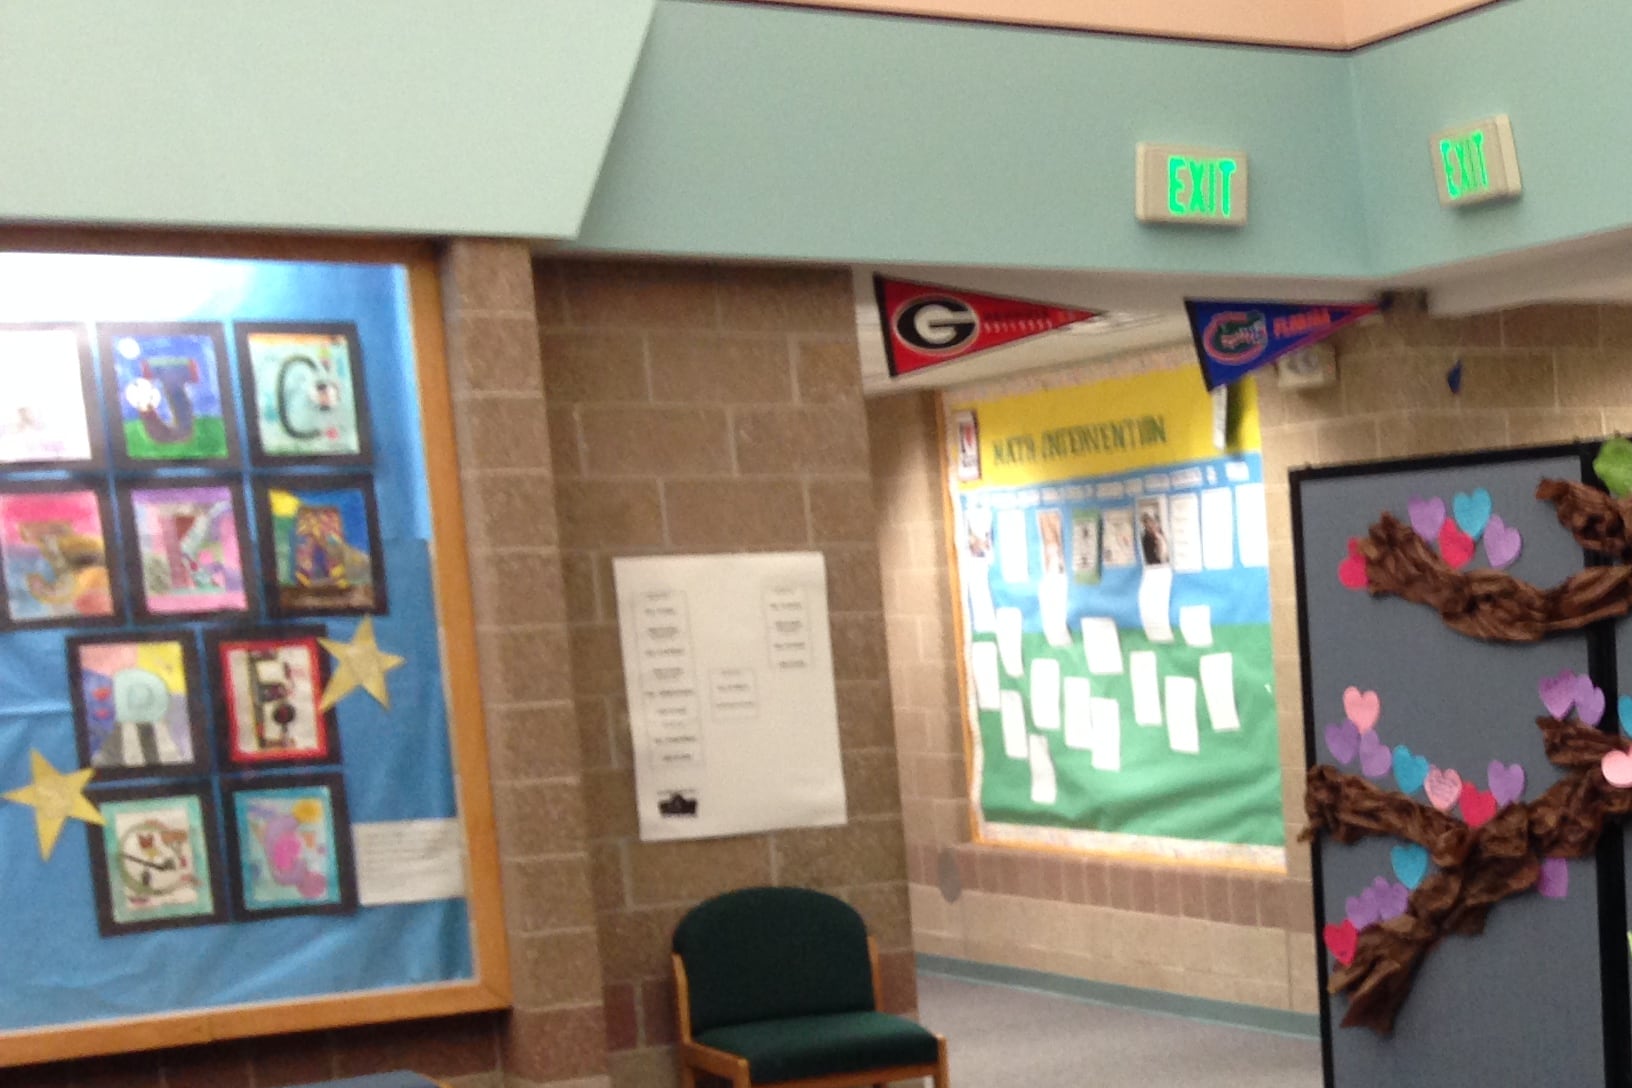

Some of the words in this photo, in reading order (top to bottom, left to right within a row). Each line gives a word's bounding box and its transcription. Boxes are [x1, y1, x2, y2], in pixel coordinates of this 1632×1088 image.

[1167, 155, 1237, 218] EXIT
[1439, 130, 1490, 200] EXIT
[894, 294, 978, 354] G
[992, 432, 1037, 466] MATH
[1041, 414, 1168, 461] INTERVENTION
